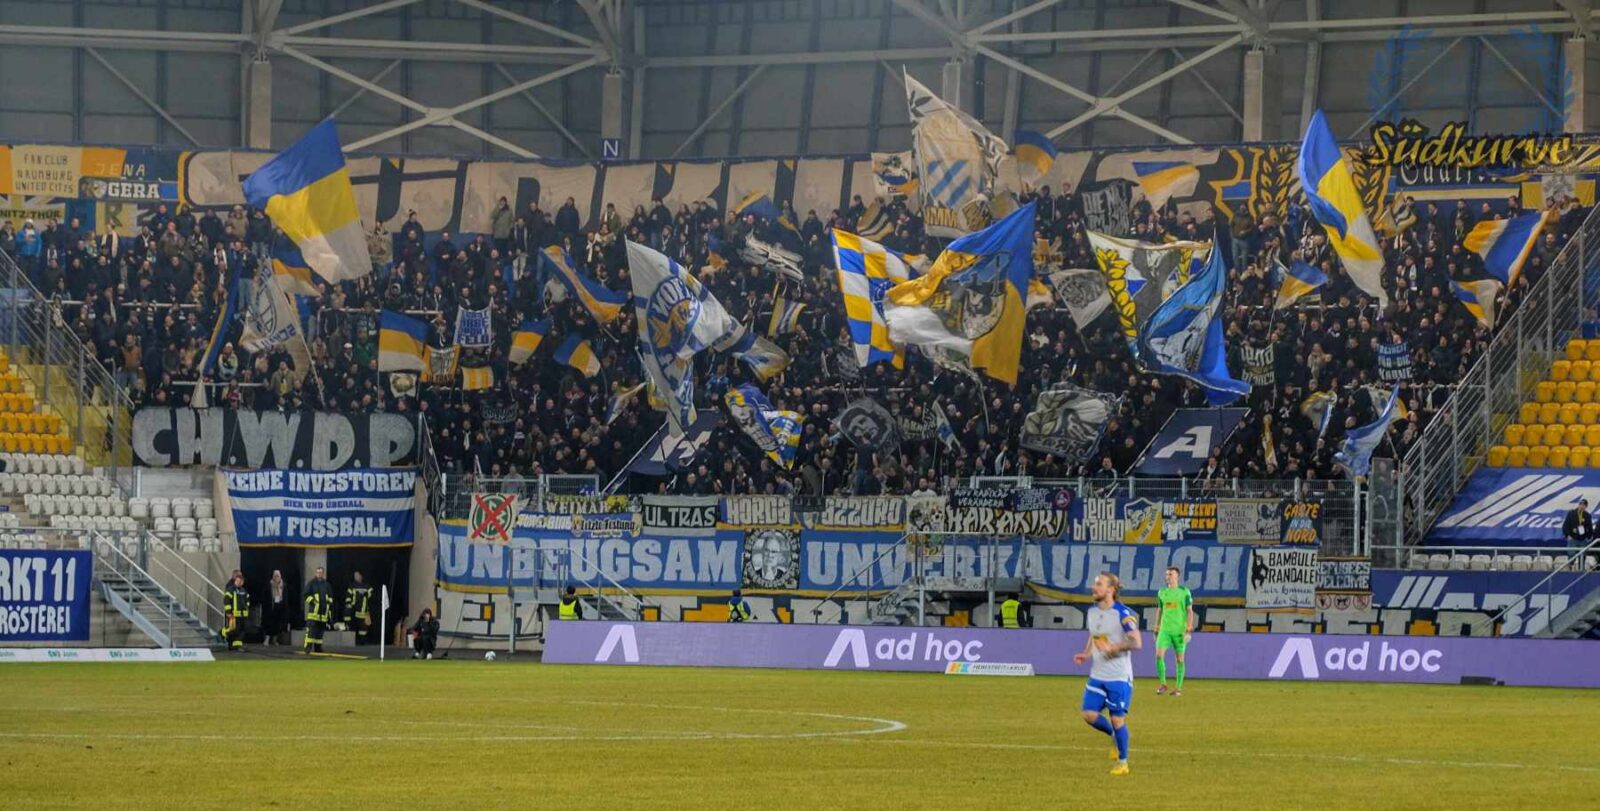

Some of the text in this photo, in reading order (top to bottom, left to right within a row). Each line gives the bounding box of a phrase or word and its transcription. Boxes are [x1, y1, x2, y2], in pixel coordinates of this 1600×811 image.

[603, 139, 619, 157] N
[108, 183, 160, 199] GERA
[226, 471, 283, 492] KEINE
[289, 471, 416, 493] INVESTOREN
[257, 516, 391, 537] IM FUSSBALL
[645, 505, 716, 528] ULTRAS
[1073, 518, 1125, 541] branco
[440, 532, 739, 582] UNBEUGSAM
[51, 557, 76, 602] 11
[875, 632, 983, 661] ad hoc
[1325, 641, 1443, 672] ad hoc
